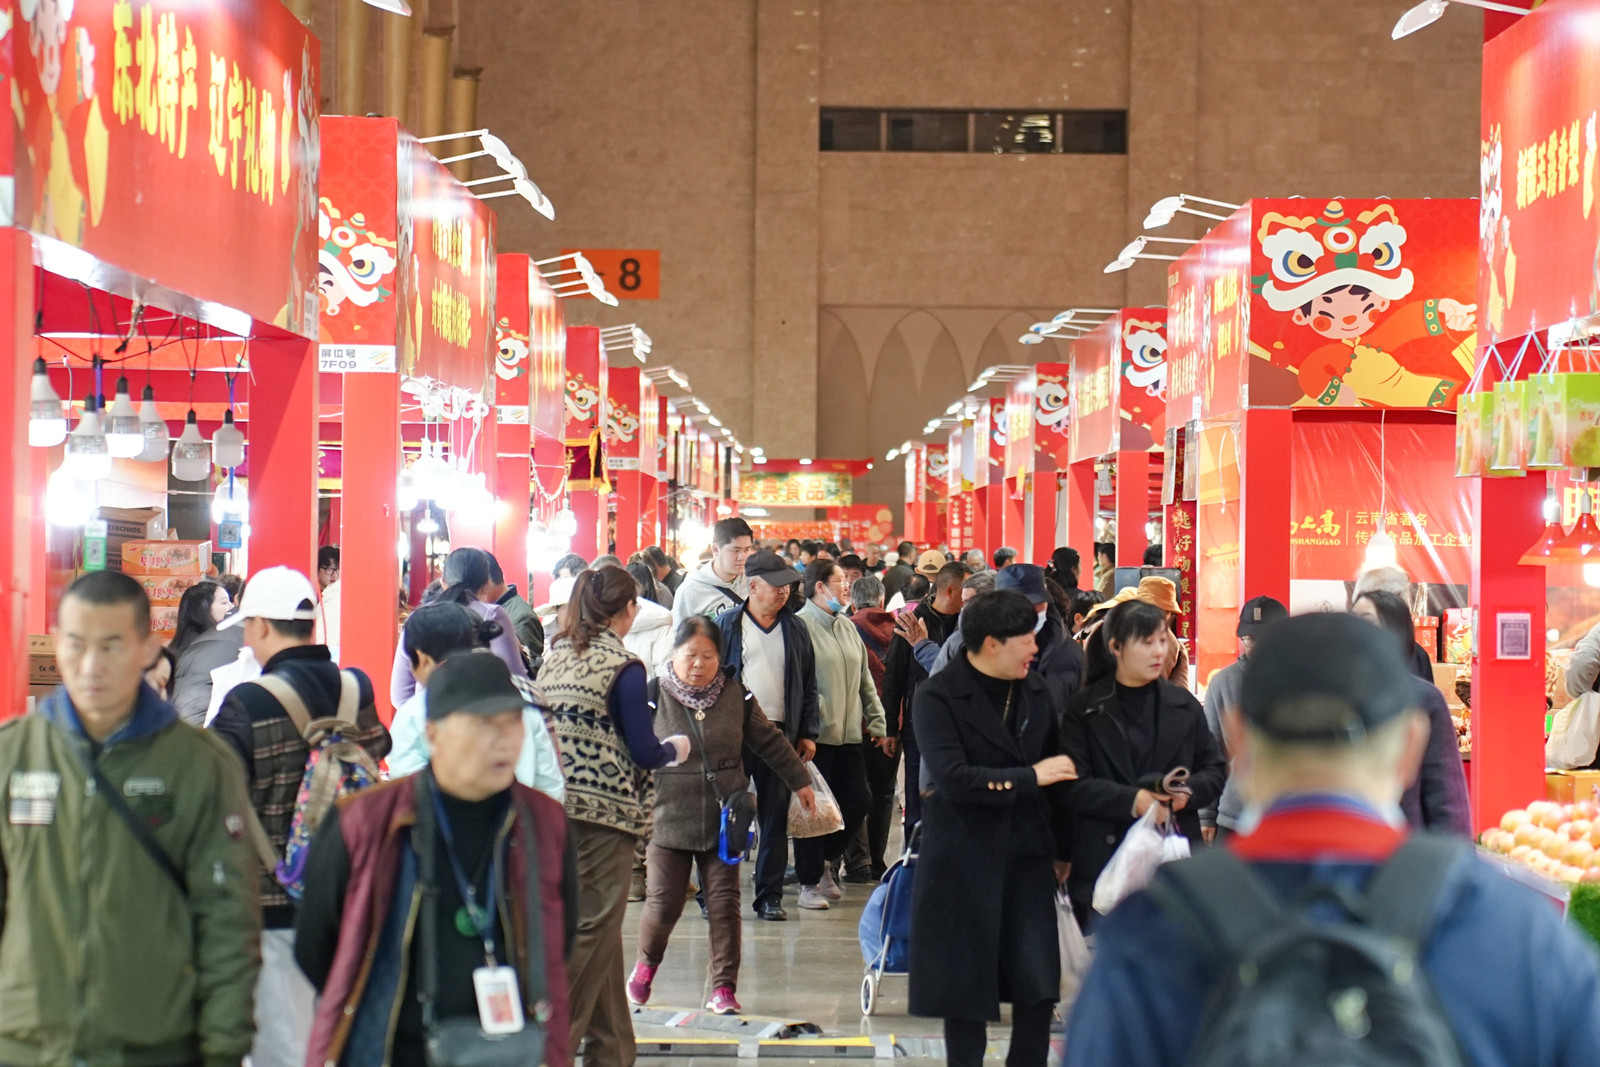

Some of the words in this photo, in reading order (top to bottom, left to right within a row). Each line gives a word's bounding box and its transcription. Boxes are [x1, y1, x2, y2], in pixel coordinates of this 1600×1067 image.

[112, 0, 198, 160] 东北特产
[208, 50, 276, 206] 辽宁礼物
[321, 348, 356, 358] 展位号
[320, 360, 357, 369] 7F09
[739, 477, 825, 501] 经典食品
[1354, 530, 1473, 547] 传食品加工企业
